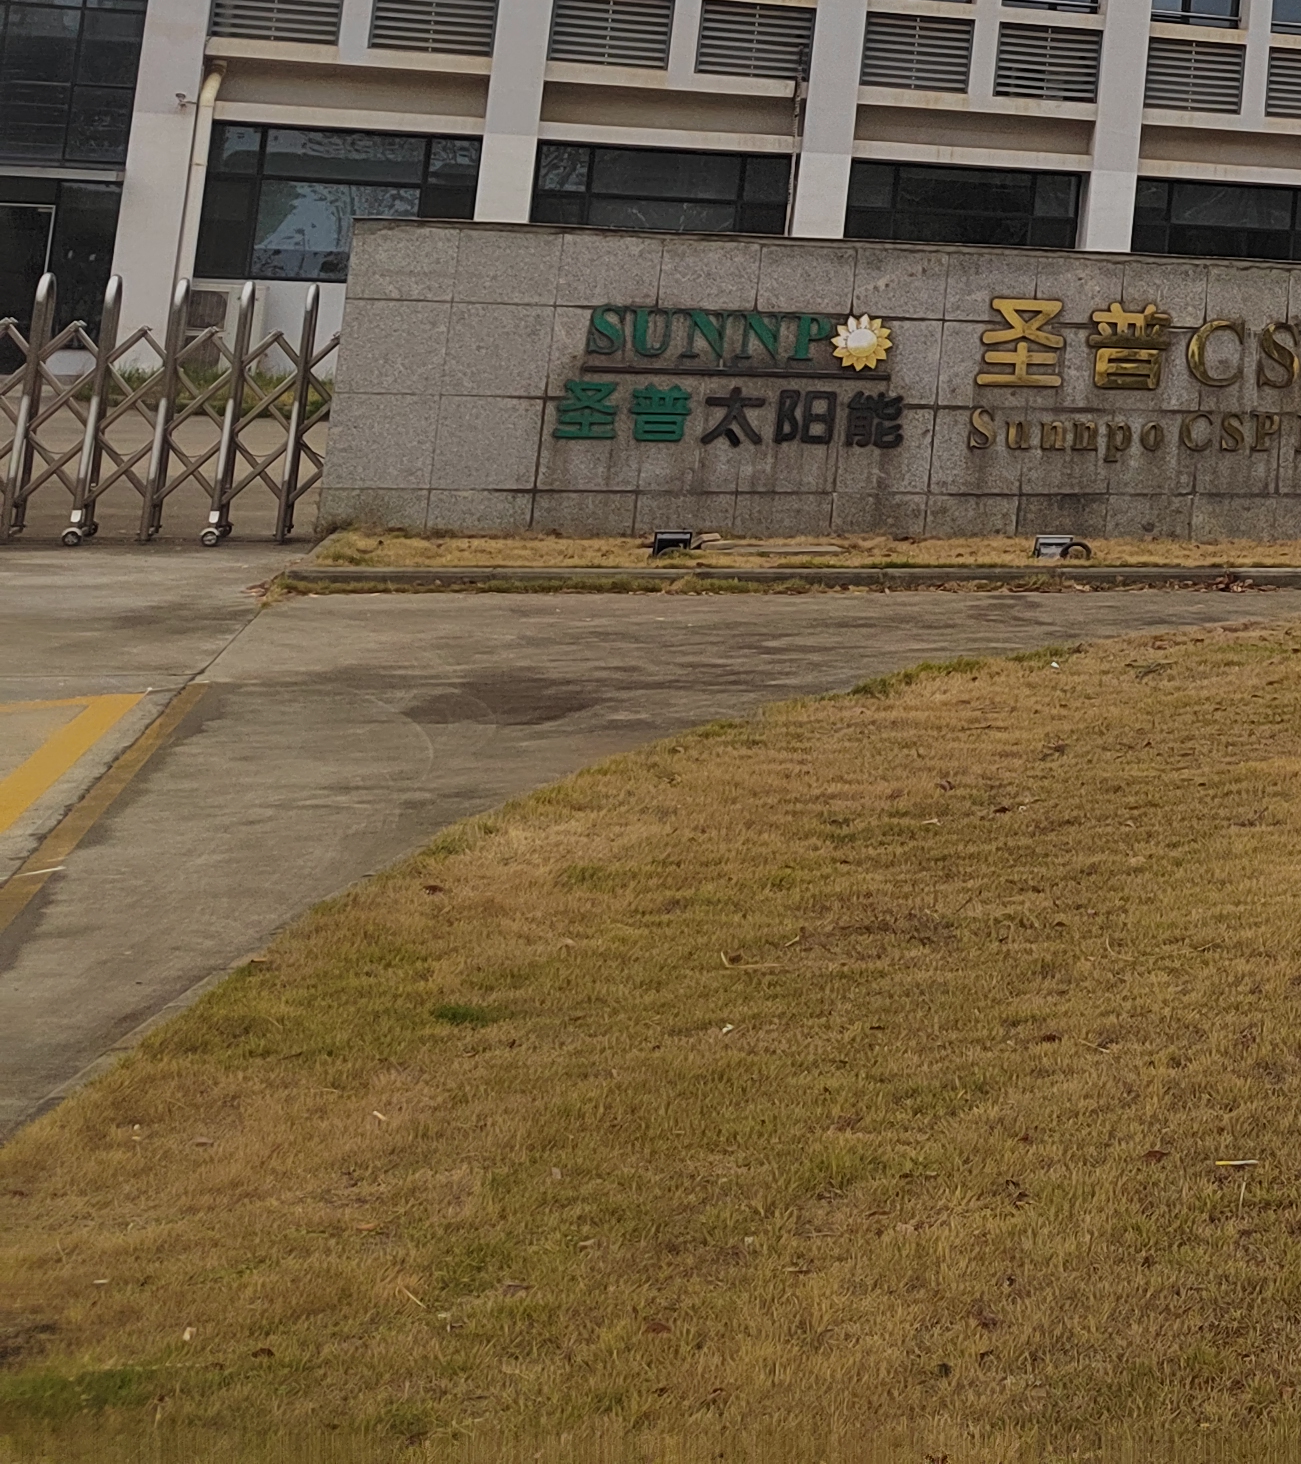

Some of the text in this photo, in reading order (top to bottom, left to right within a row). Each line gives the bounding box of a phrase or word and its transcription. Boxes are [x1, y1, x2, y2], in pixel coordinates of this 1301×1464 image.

[552, 380, 904, 449] 圣普太阳能
[968, 407, 1163, 463] Sunnpo
[1180, 410, 1281, 452] CSP
